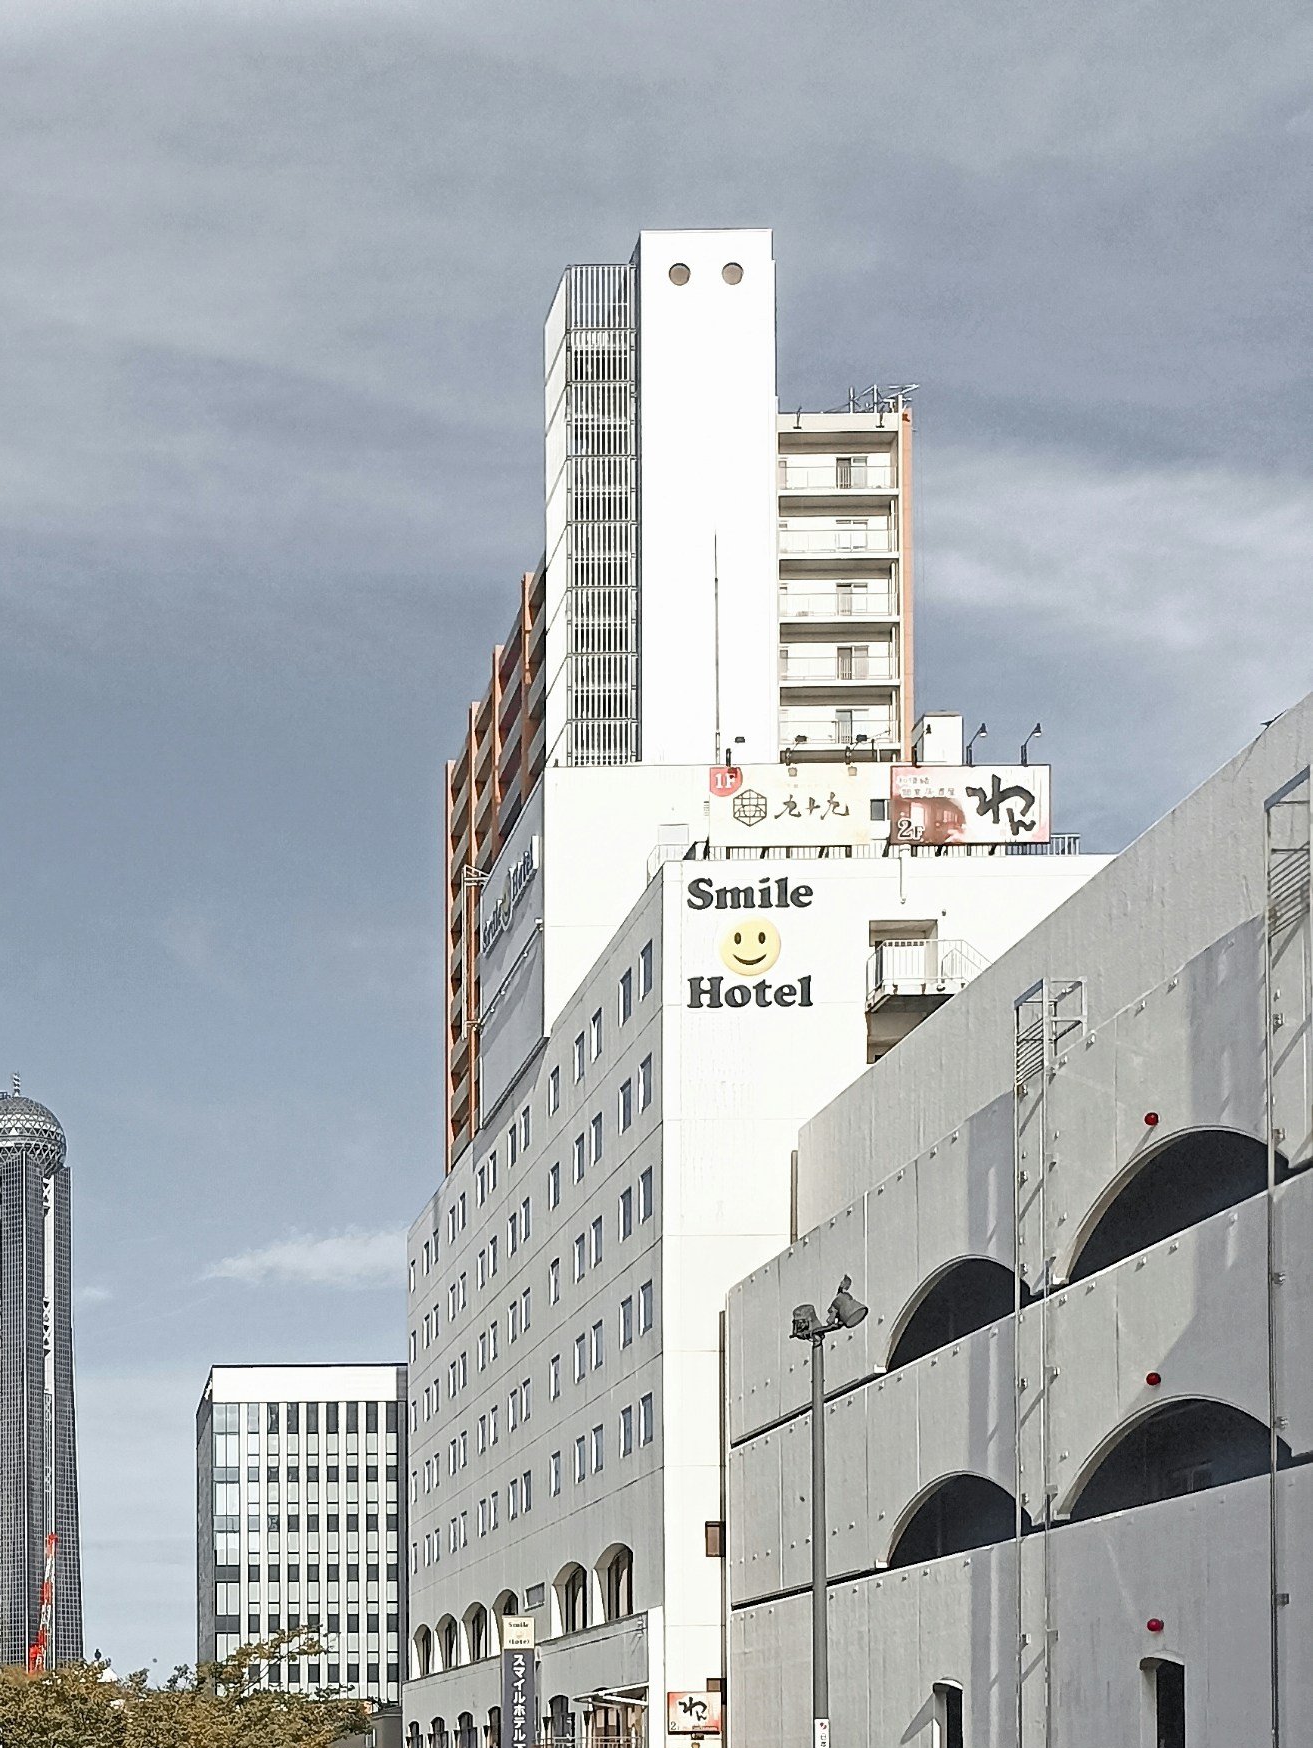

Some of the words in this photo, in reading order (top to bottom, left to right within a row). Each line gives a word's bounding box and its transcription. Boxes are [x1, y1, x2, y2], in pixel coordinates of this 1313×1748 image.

[715, 772, 736, 789] 1F
[966, 774, 1036, 836] わん
[898, 819, 924, 840] 2F
[687, 877, 814, 910] Smile
[687, 975, 814, 1009] Hotel
